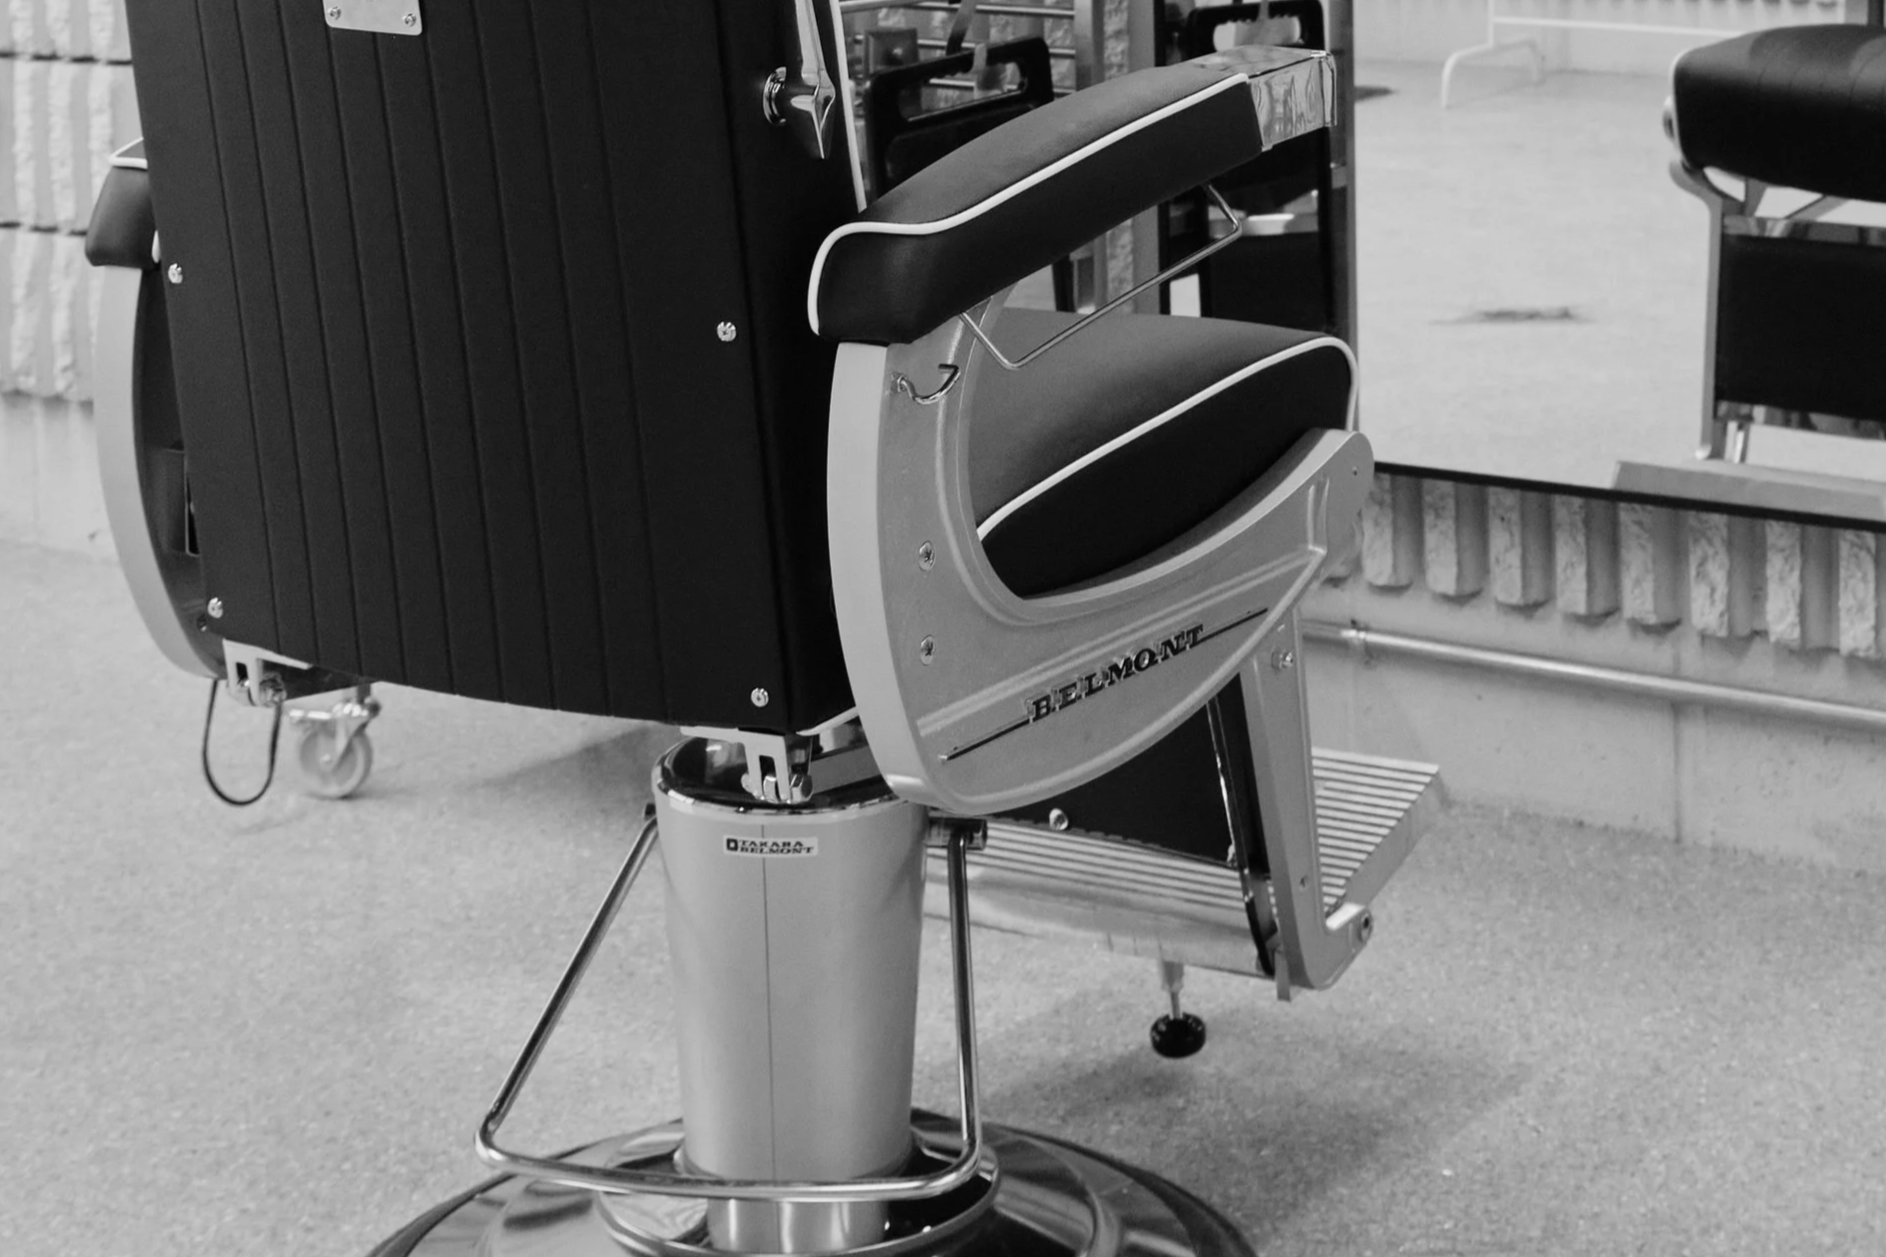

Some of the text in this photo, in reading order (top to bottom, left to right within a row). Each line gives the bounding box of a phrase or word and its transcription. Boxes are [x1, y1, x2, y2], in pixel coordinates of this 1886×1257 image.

[1027, 624, 1203, 722] BELMONT
[740, 839, 803, 847] TAKARA
[740, 846, 814, 854] BELMONT
